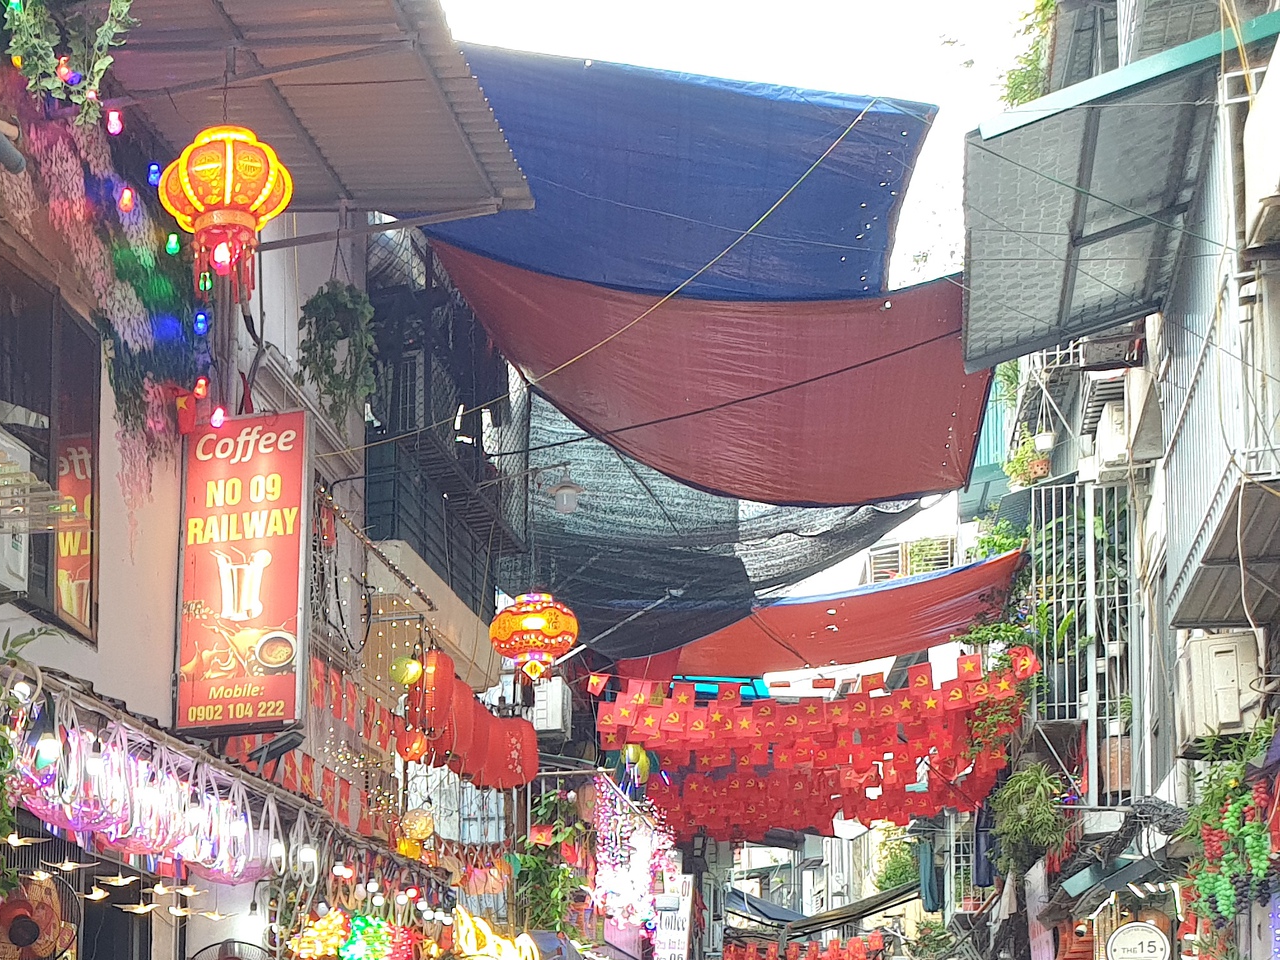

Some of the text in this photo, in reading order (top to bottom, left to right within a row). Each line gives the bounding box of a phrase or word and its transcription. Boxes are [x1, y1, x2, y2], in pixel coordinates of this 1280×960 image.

[195, 425, 297, 465] Coffee
[206, 473, 281, 508] NO 09
[187, 507, 298, 545] RAILWAY
[209, 684, 265, 700] Mobile:
[187, 700, 285, 722] 0902 104 222
[1137, 940, 1157, 954] 15
